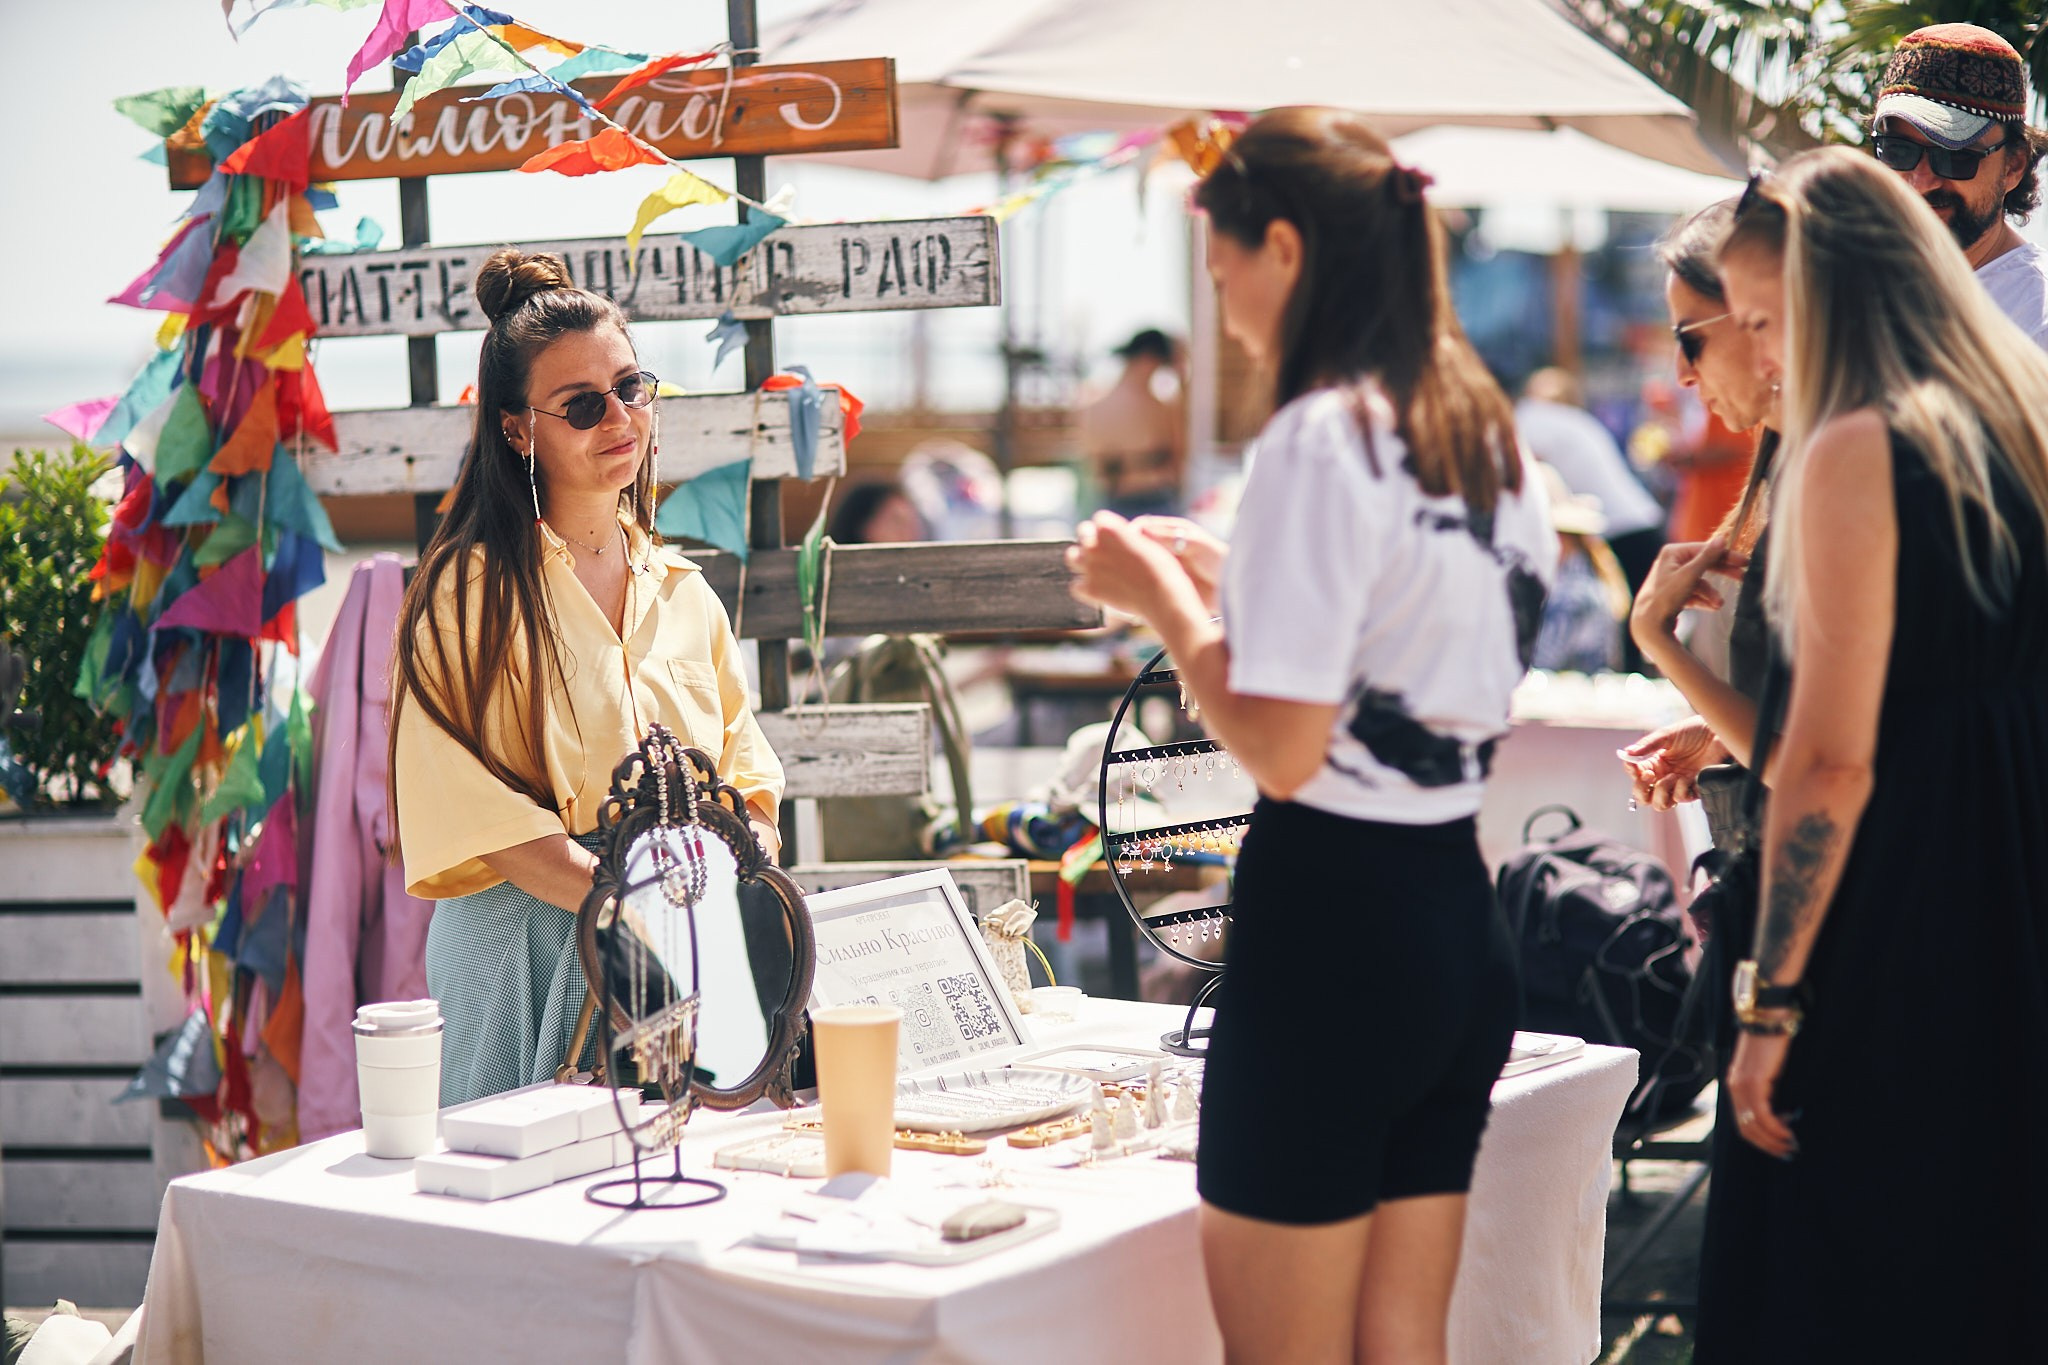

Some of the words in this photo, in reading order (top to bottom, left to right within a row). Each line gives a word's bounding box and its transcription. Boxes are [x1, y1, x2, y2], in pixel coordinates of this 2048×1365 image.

[841, 232, 952, 299] РАФ
[816, 939, 882, 966] Сильно
[880, 923, 955, 956] Красиво
[850, 968, 899, 986] Украшения
[900, 965, 914, 975] как
